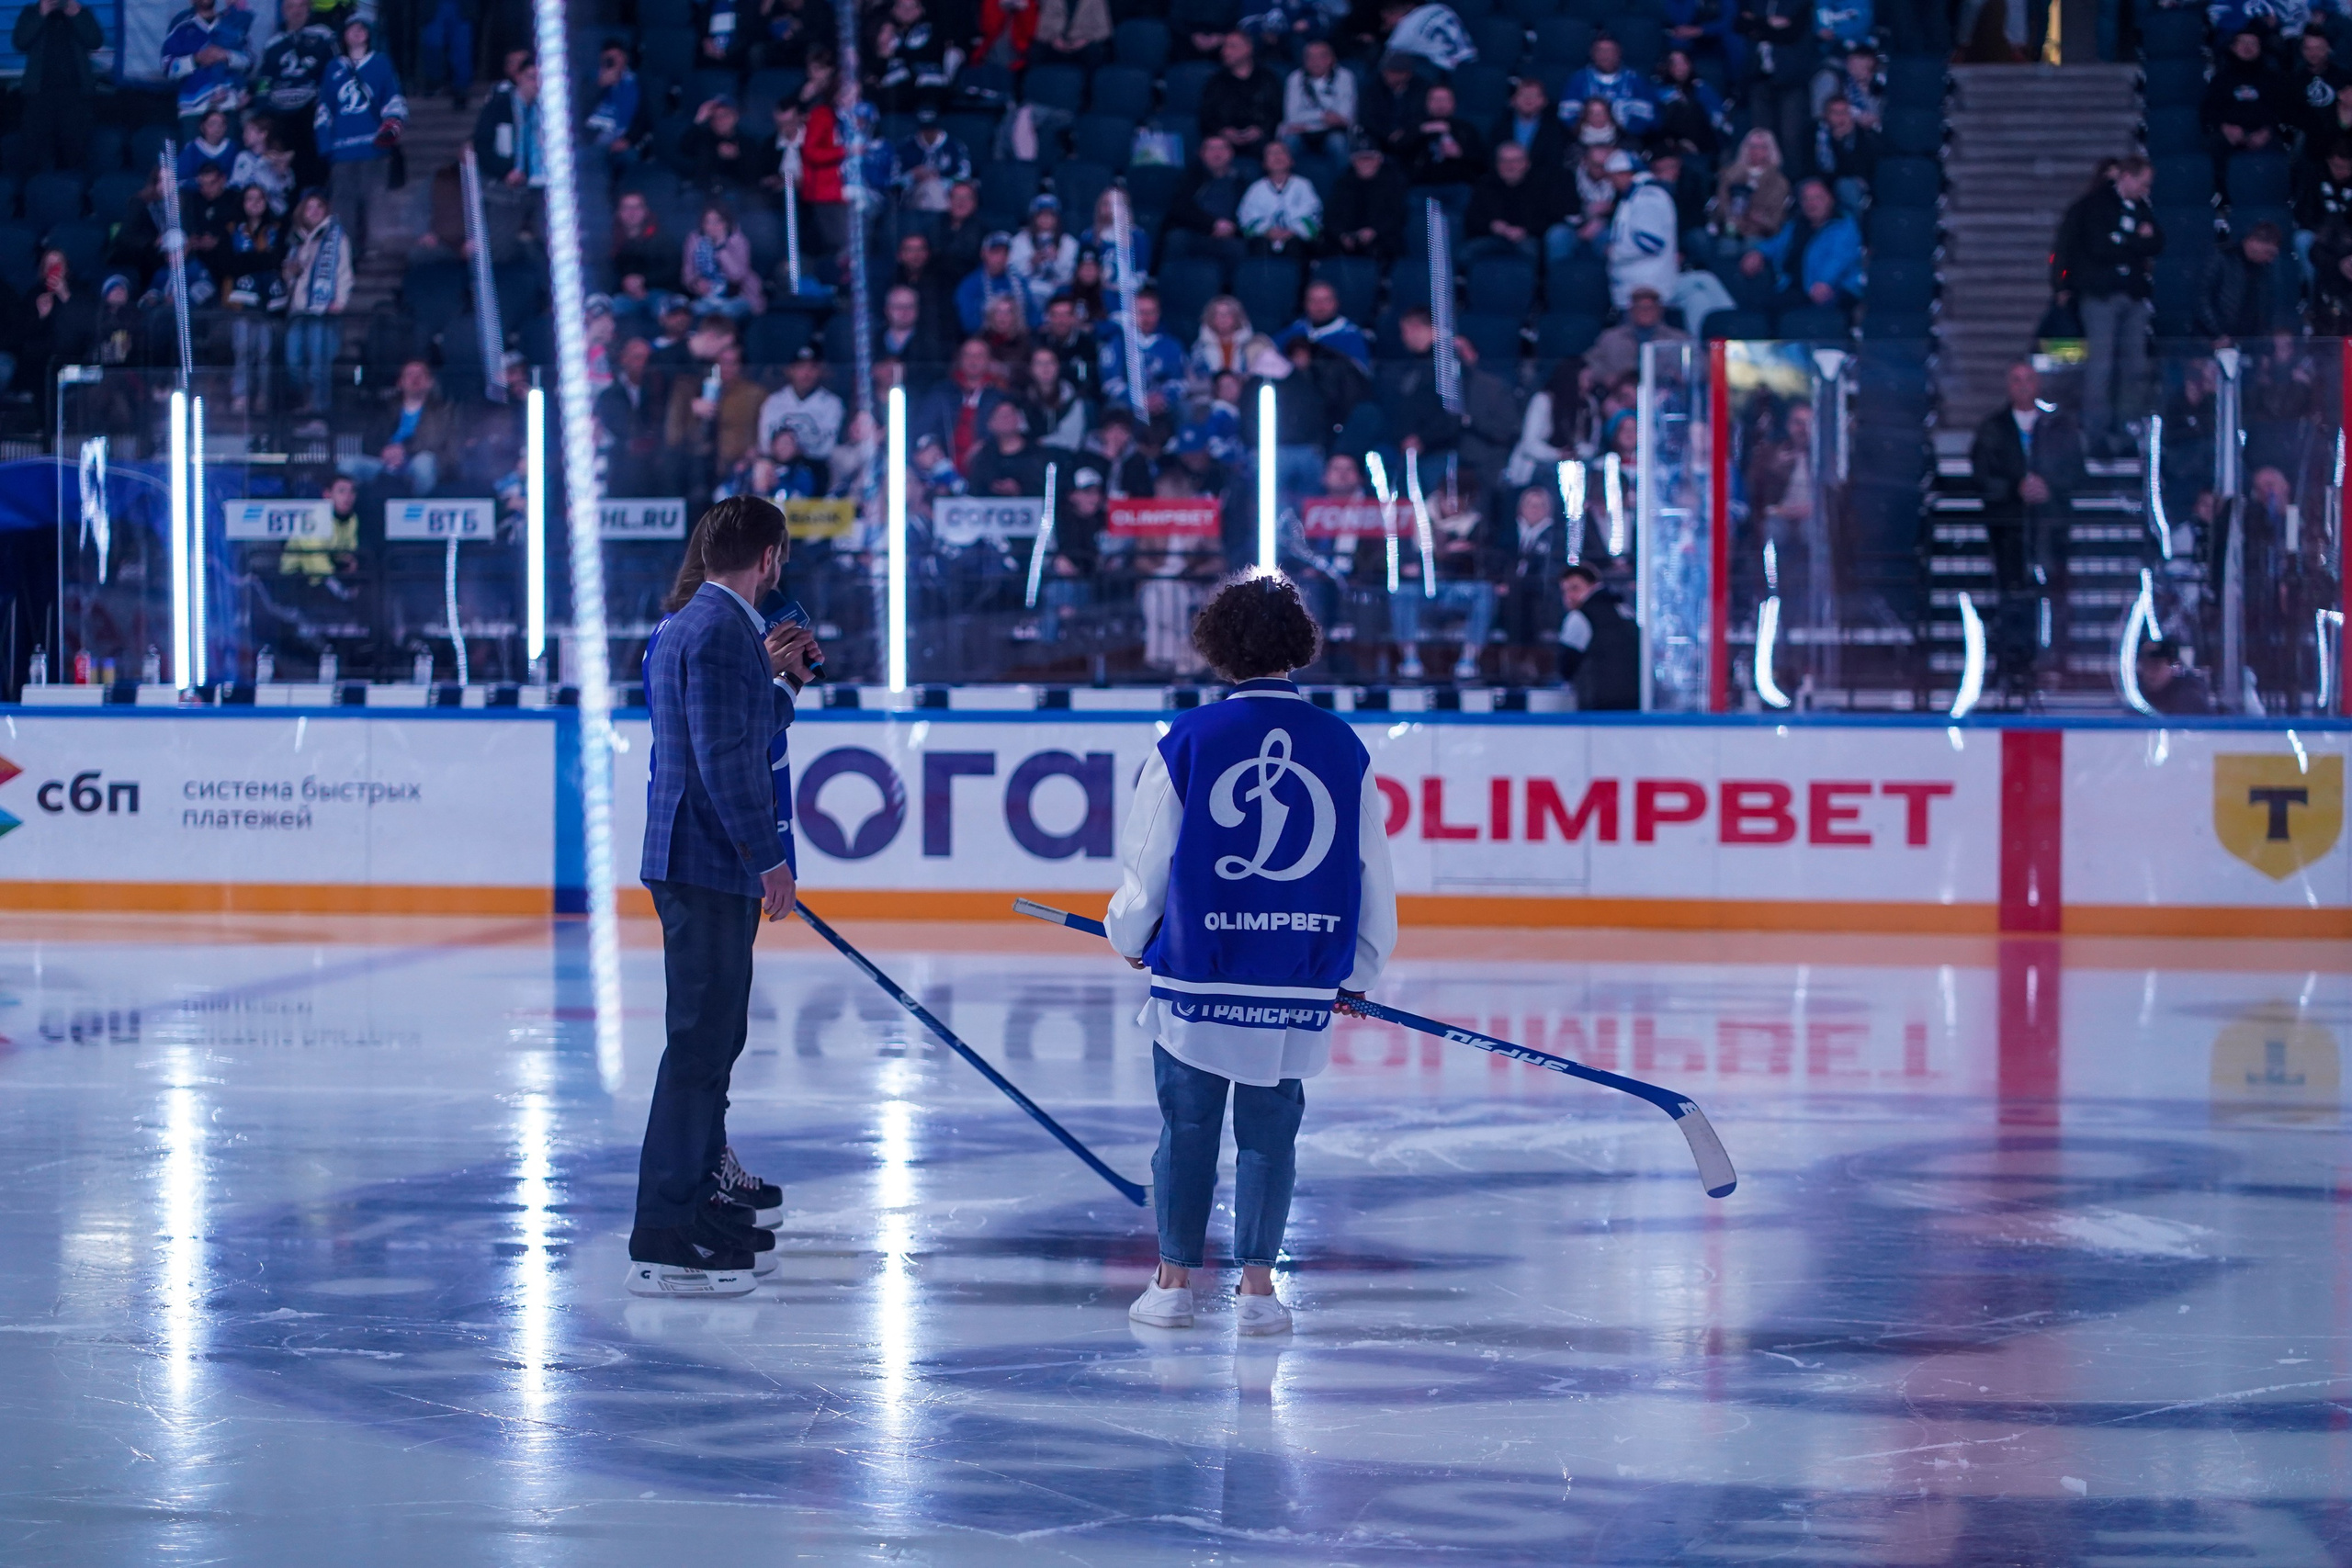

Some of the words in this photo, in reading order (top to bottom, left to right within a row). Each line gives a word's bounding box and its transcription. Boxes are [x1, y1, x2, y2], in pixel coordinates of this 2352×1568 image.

[267, 510, 316, 533] ВТБ
[429, 508, 478, 532] ВТБ
[601, 508, 677, 529] HL.RU
[1305, 505, 1415, 530] FONBT
[184, 779, 294, 801] система
[301, 775, 422, 806] быстрых
[183, 806, 313, 829] платежей
[1204, 911, 1341, 933] OLIMPBET
